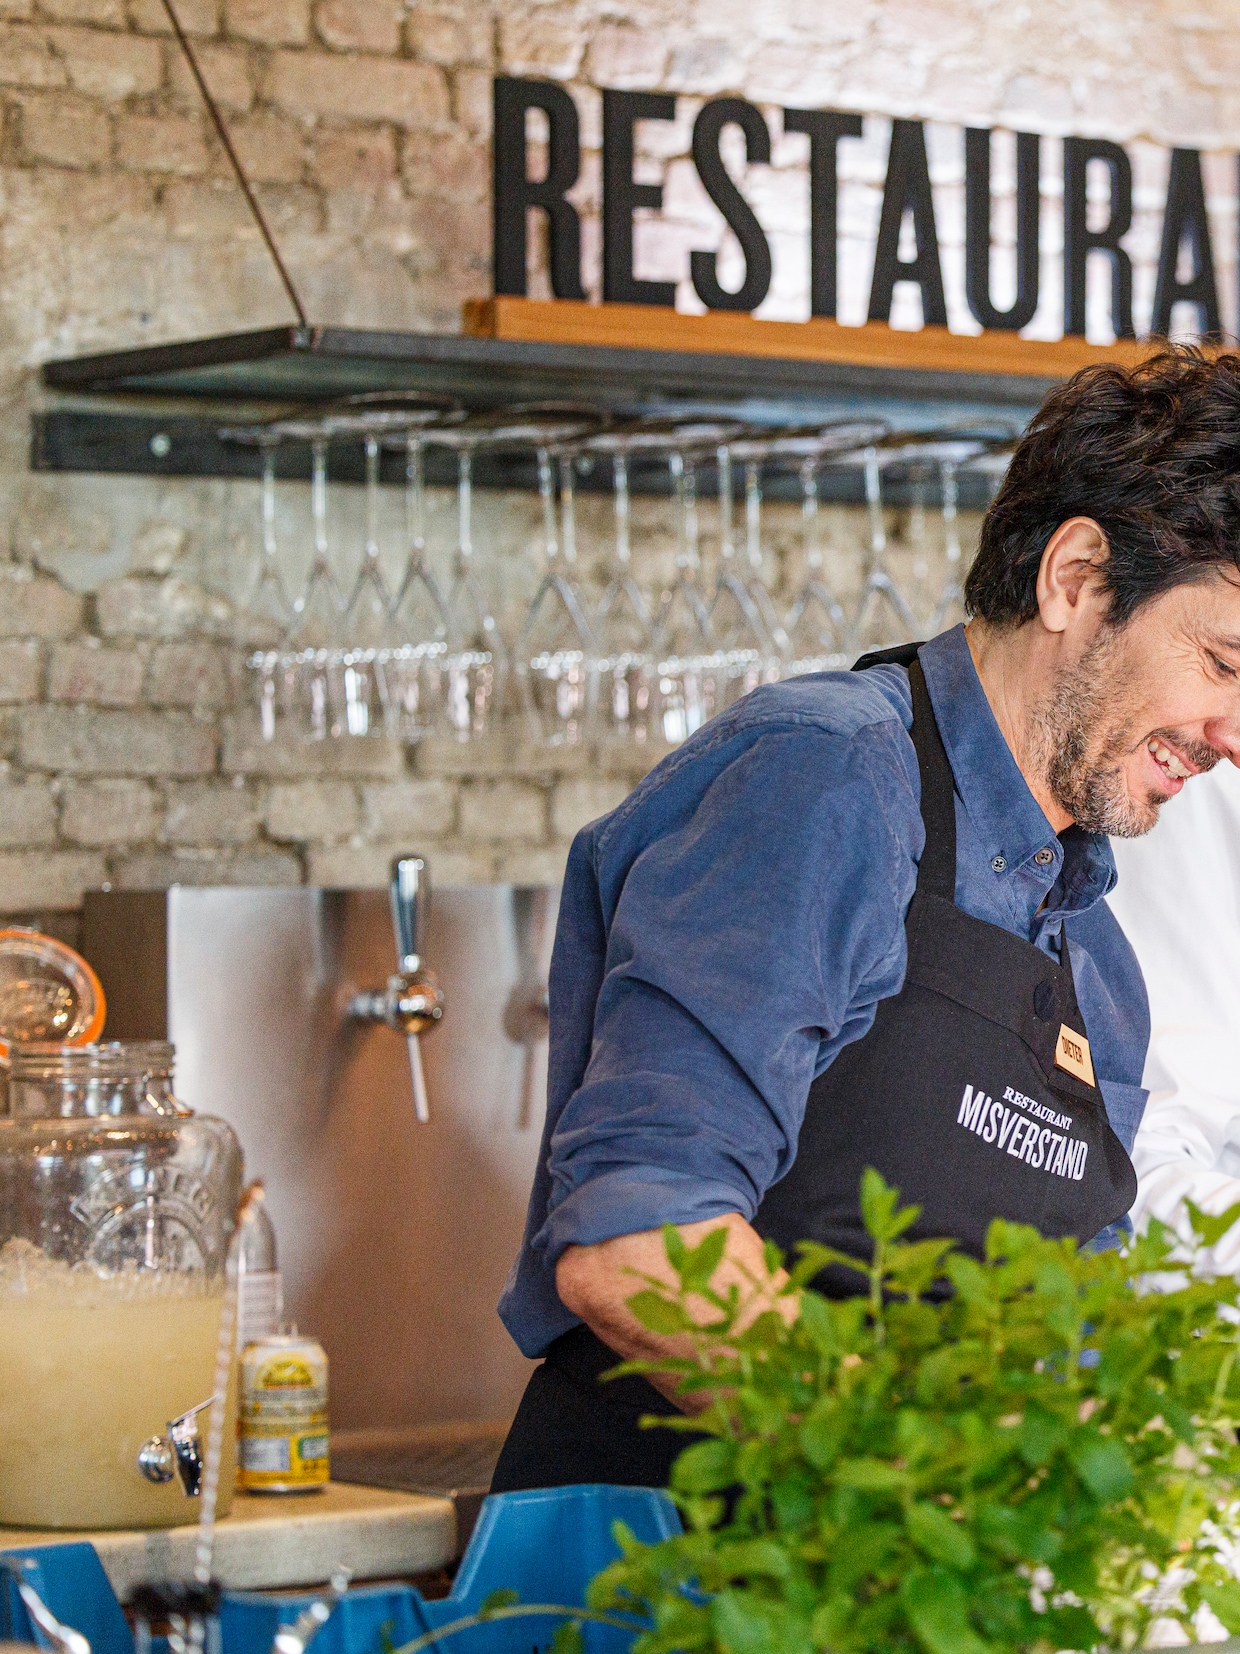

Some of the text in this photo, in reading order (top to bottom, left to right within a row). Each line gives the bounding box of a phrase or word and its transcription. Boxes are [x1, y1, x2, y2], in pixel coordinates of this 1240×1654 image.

[1061, 1036, 1083, 1065] DIETER
[1003, 1086, 1072, 1130] RESTAURANT
[957, 1084, 1088, 1180] MISVERSTAND
